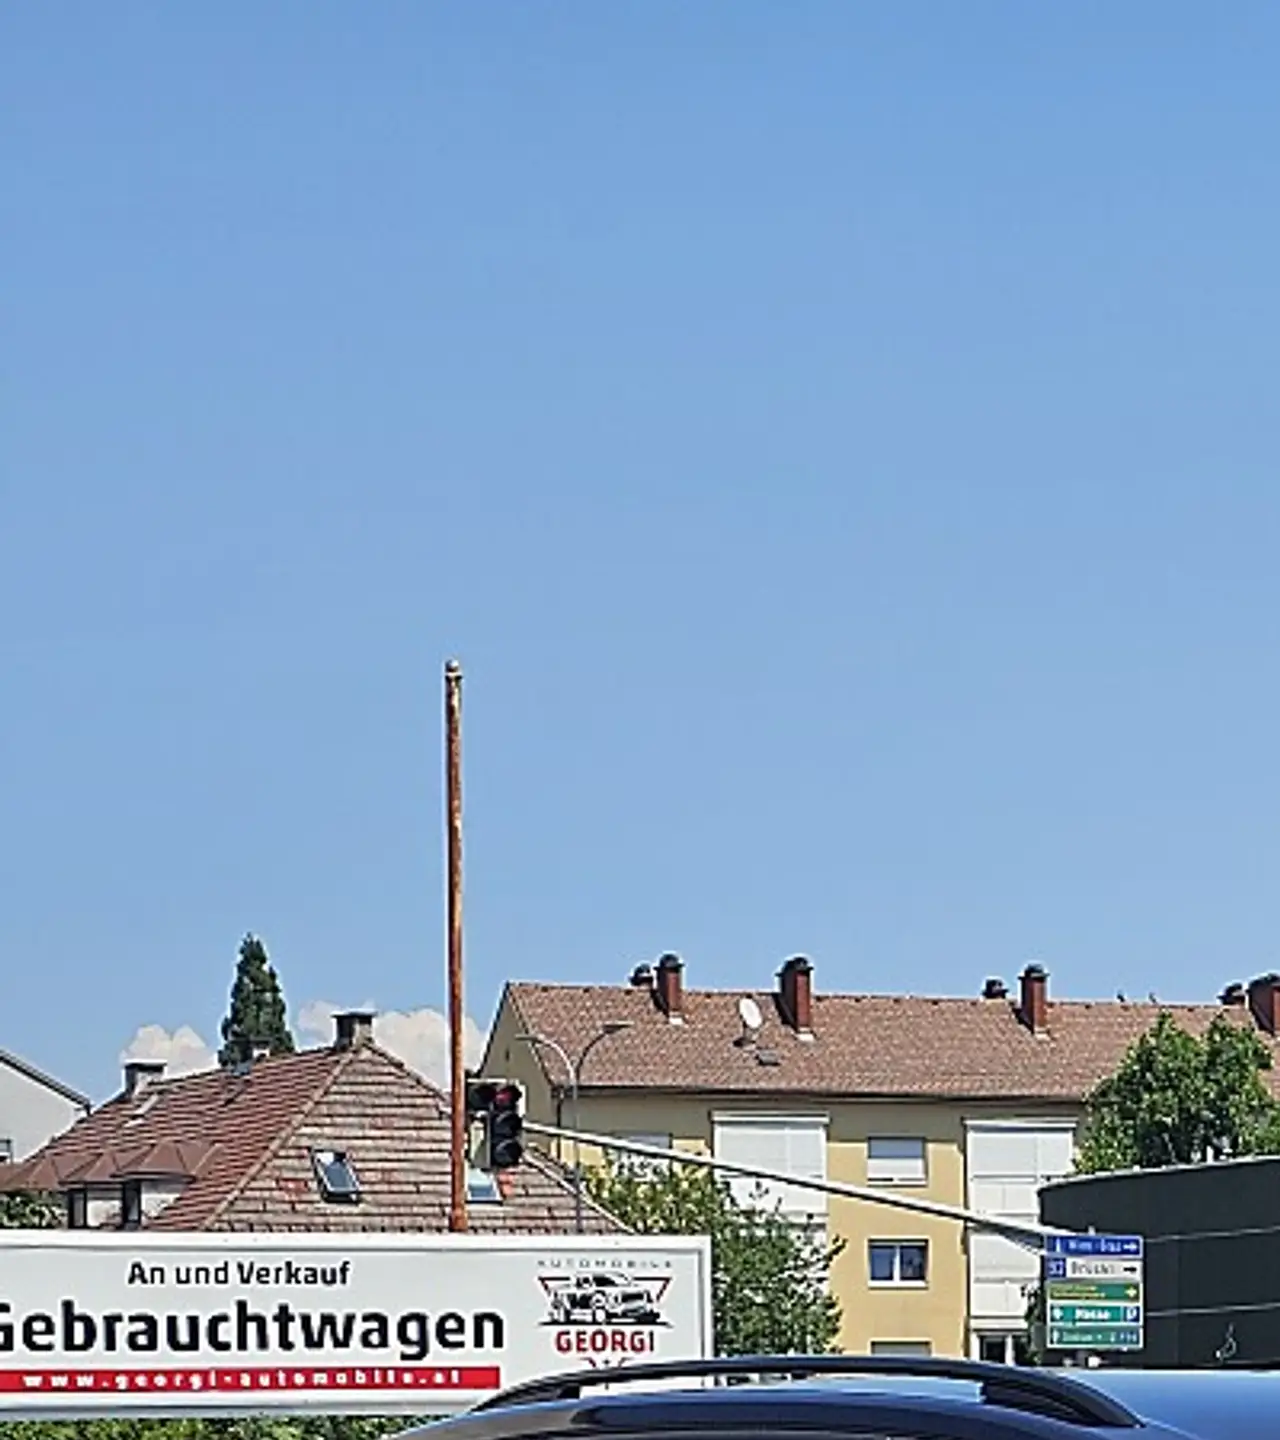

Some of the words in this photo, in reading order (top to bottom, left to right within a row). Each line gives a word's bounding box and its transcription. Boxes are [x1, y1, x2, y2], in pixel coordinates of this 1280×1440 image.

[127, 1261, 165, 1285] An
[175, 1260, 229, 1285] und
[237, 1260, 350, 1285] Verkauf
[555, 1329, 655, 1353] GEORGI
